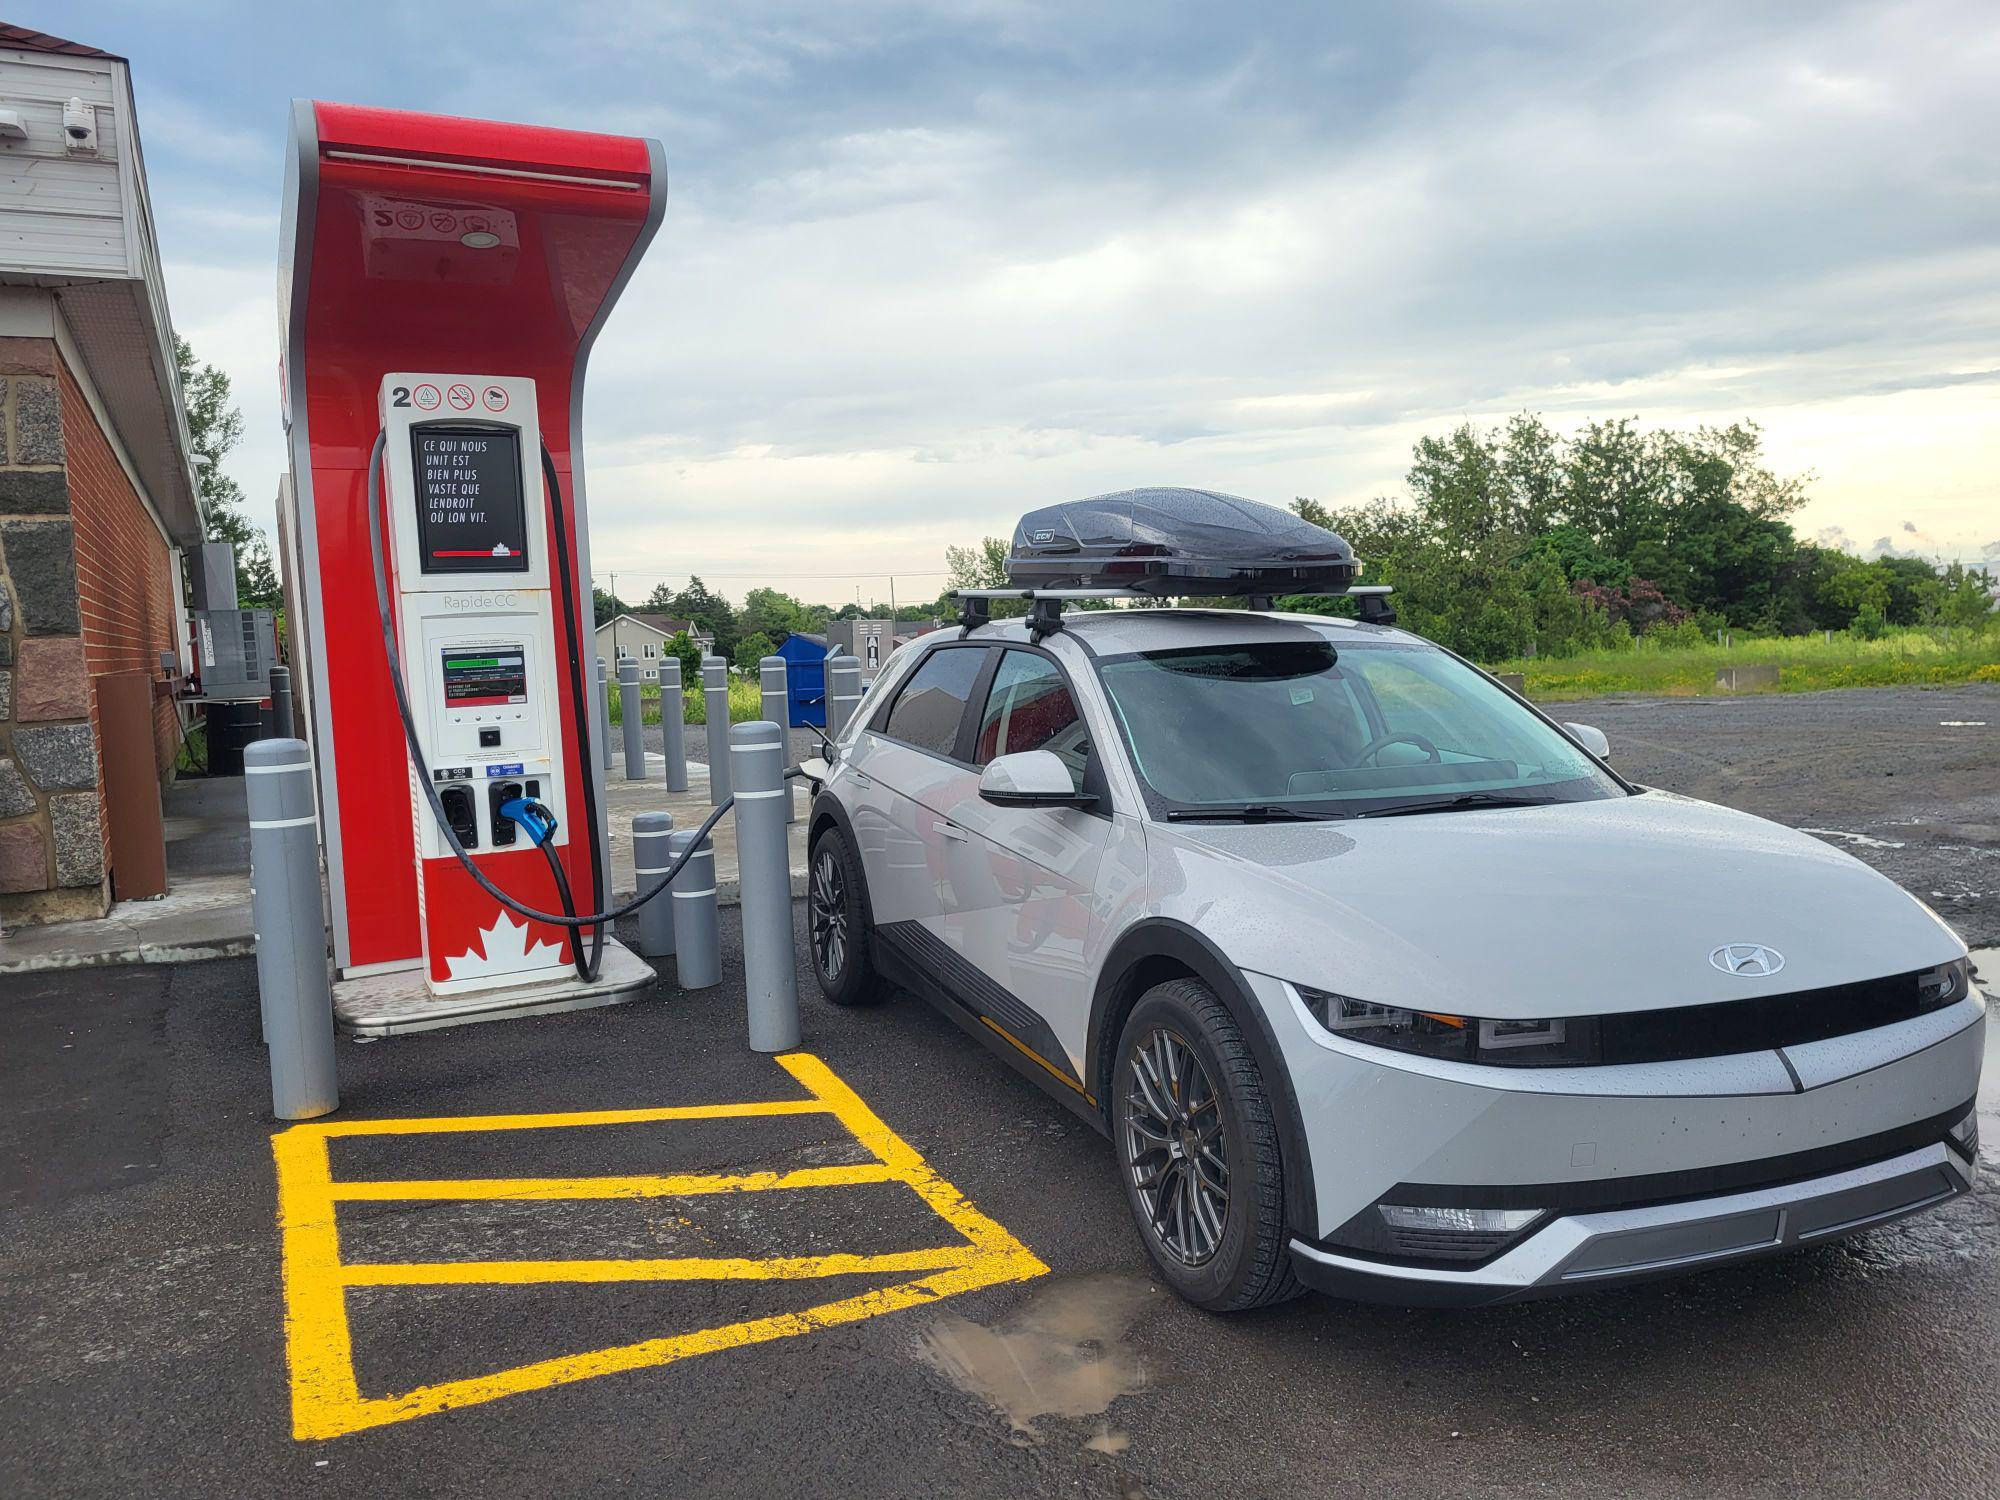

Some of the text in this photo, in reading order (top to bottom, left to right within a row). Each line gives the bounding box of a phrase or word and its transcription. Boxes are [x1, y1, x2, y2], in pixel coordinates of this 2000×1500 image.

[392, 387, 411, 407] 2
[424, 440, 487, 452] CE QUI NOUS
[426, 455, 470, 466] UNIT EST
[427, 469, 477, 481] BIEN PLUS
[428, 483, 480, 495] VASTE QUE
[429, 497, 475, 509] LENDROIT
[430, 510, 487, 523] OÙ LON VIT.
[444, 594, 517, 611] Rapide CC
[867, 636, 878, 669] AIR
